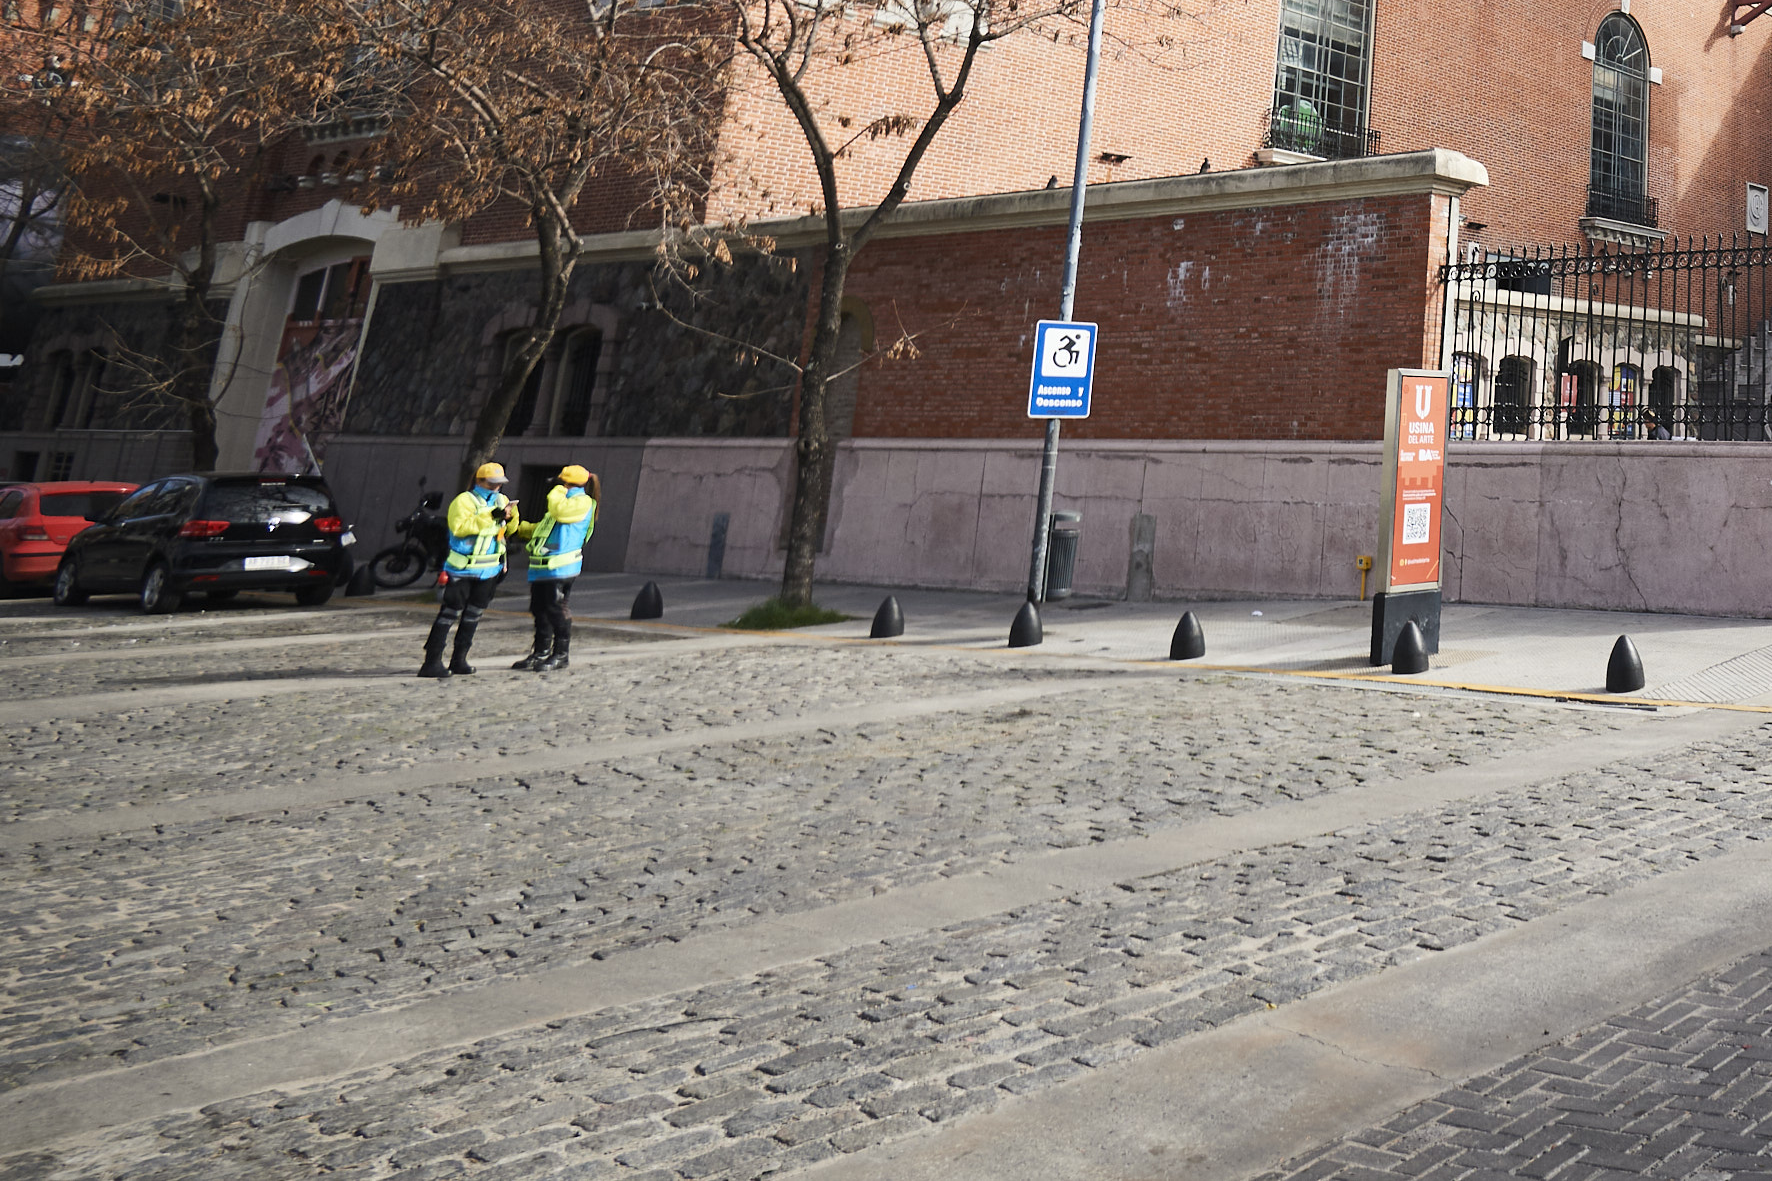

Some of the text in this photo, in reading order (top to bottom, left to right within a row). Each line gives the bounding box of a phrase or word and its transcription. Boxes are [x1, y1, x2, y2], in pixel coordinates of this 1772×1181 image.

[1038, 384, 1085, 397] Ascenso y
[1036, 397, 1082, 407] Descenso
[1409, 421, 1434, 434] USINA
[1408, 435, 1434, 444] DEL ARTE
